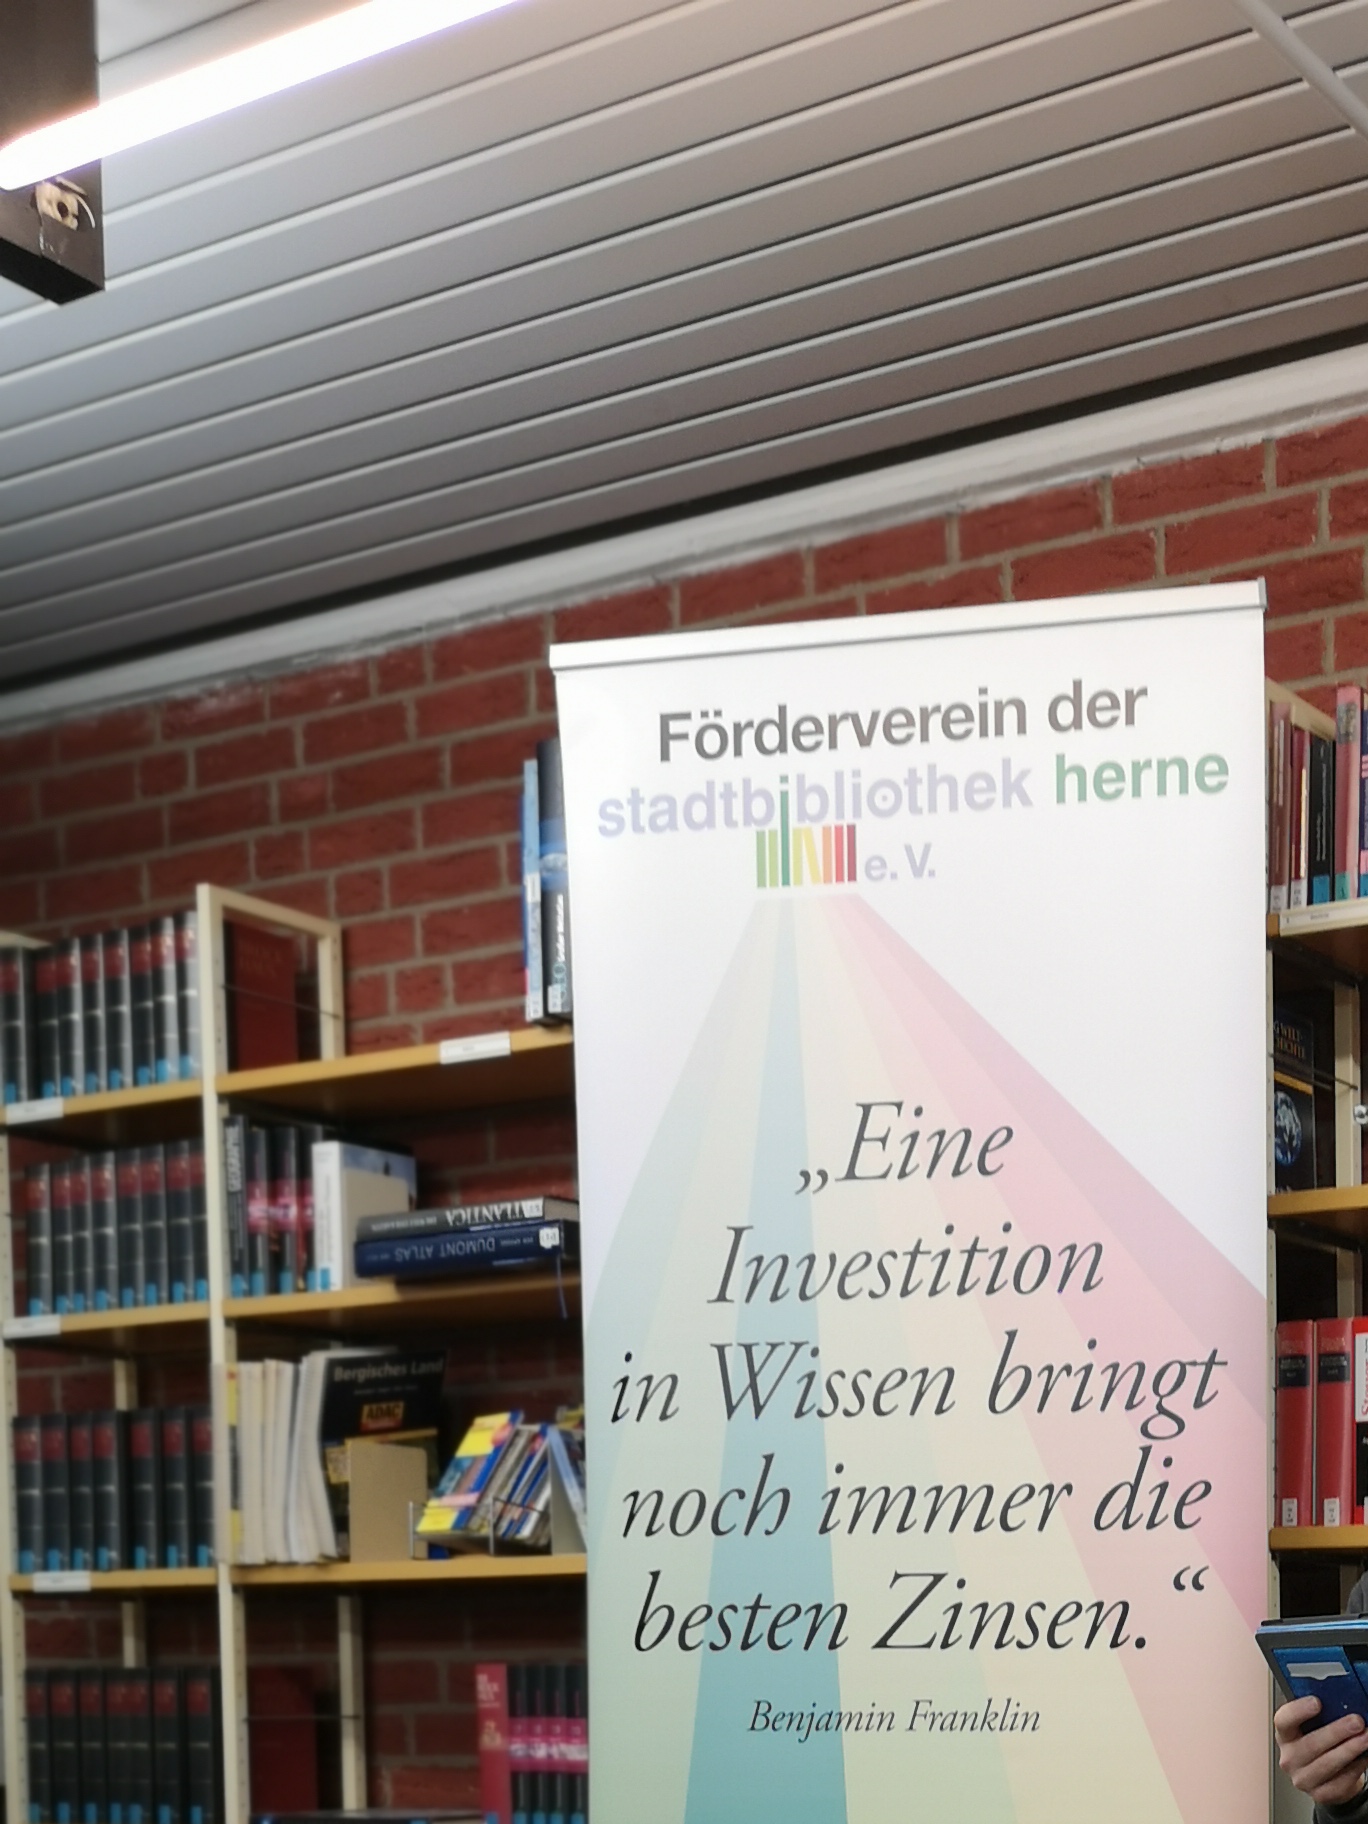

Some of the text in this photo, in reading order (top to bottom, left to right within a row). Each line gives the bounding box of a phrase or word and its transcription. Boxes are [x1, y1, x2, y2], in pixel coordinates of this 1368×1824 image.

[658, 678, 1149, 763] Förderverein der
[597, 752, 1230, 838] stadtbibliothek herne
[446, 1200, 526, 1227] TLANTICA
[394, 1246, 434, 1263] ATLAS
[438, 1237, 496, 1259] DUMONT
[706, 1221, 1105, 1305] Investition
[334, 1357, 445, 1383] Bergisches Land
[609, 1329, 1229, 1441] in Wissen bringt
[366, 1402, 400, 1420] ADAC
[622, 1444, 1213, 1540] noch immer die
[632, 1570, 850, 1653] besten
[748, 1697, 1042, 1744] Benjamin Franklin
